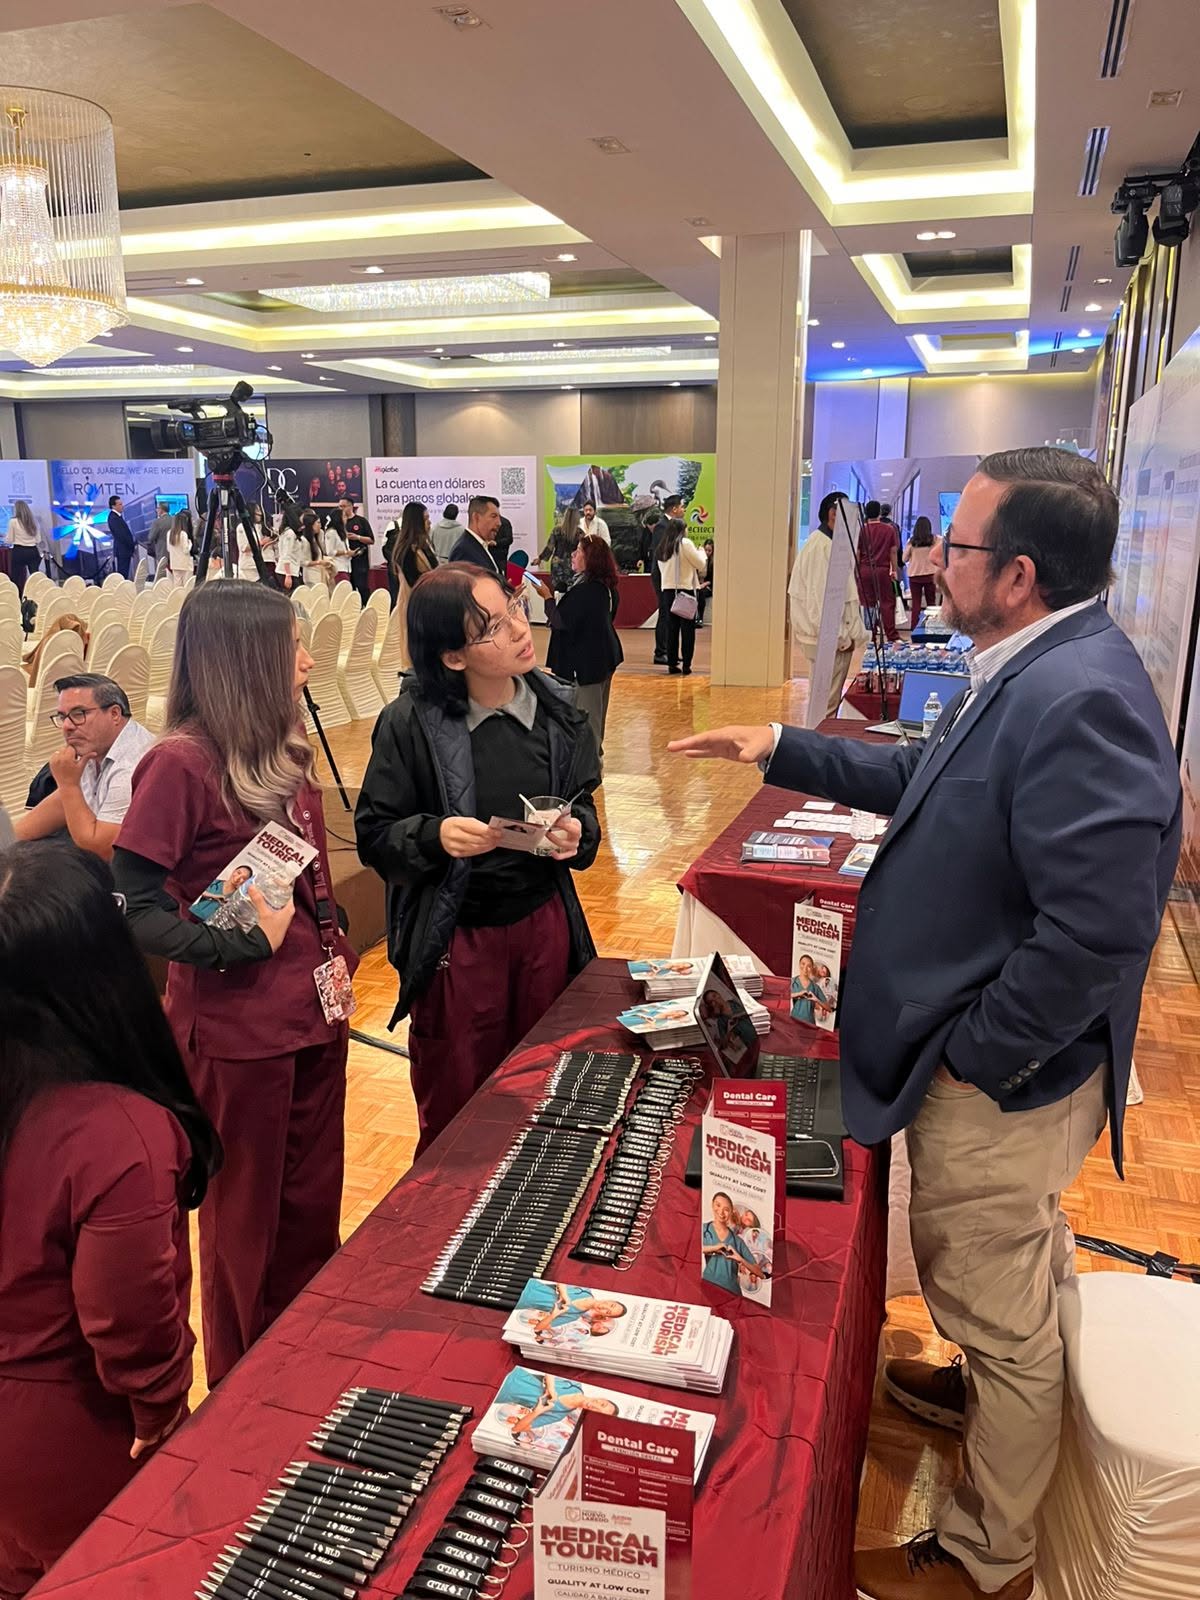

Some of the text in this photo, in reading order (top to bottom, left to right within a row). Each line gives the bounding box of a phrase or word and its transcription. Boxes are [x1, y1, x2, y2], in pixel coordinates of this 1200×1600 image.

[375, 478, 486, 489] La cuenta en dólares
[376, 493, 479, 506] para pagos globale
[256, 836, 302, 867] TOURIS
[261, 831, 304, 865] MEDICAL
[796, 915, 840, 933] MEDICAL
[796, 923, 840, 941] TOURISM
[723, 1092, 777, 1101] Dental Care
[706, 1133, 771, 1164] MEDICAL
[706, 1144, 771, 1176] TOURISM
[651, 1305, 678, 1356] TOURISM
[664, 1306, 690, 1356] MEDICAL
[597, 1431, 679, 1456] Dental Care
[494, 1460, 515, 1472] NLD
[486, 1477, 507, 1489] NLD
[477, 1493, 510, 1509] I NLD
[466, 1511, 488, 1523] NLD
[582, 1511, 606, 1519] NUEVO
[456, 1531, 478, 1544] NLD
[541, 1524, 658, 1552] MEDICAL
[324, 1546, 341, 1558] NLD
[445, 1546, 467, 1560] NLD
[540, 1541, 658, 1568] TOURISM
[437, 1563, 472, 1580] I NLD
[557, 1563, 641, 1580] TURISMO MÉDICO
[427, 1580, 463, 1596] I NLD
[547, 1578, 651, 1595] QUALITY AT LOW COST
[556, 1591, 589, 1600] CALIDAD
